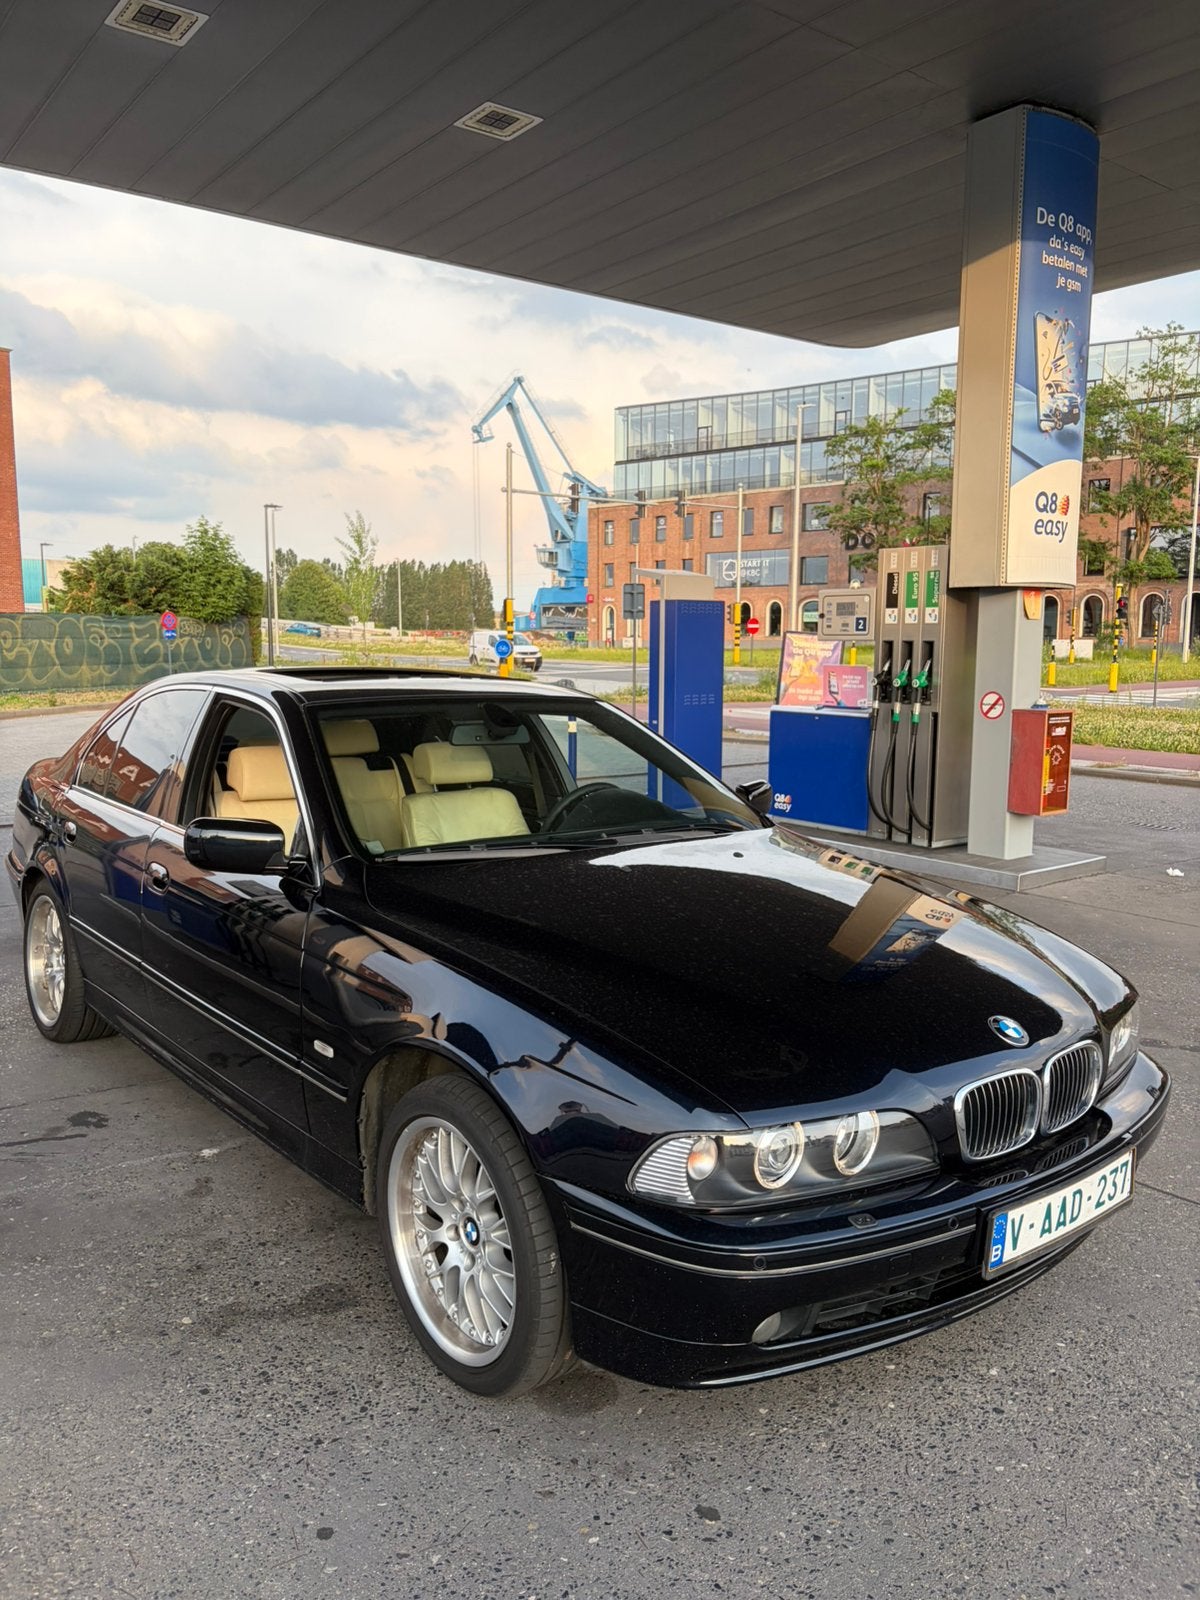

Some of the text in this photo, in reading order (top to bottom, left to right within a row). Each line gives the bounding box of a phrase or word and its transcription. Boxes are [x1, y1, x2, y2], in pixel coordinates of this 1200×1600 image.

[1036, 206, 1056, 227] De
[1058, 212, 1074, 233] Q8
[1049, 234, 1085, 261] da's easy
[1042, 250, 1088, 278] betalen met
[1055, 272, 1082, 292] je gsm
[1035, 491, 1058, 514] Q8
[1034, 518, 1069, 543] easy
[740, 559, 770, 568] START IT
[891, 572, 899, 595] Diesel
[912, 571, 919, 582] 95
[911, 583, 919, 600] Euro
[932, 583, 940, 604] Super
[857, 619, 865, 630] 2
[774, 793, 785, 802] Q8
[774, 802, 792, 812] easy
[1011, 1160, 1129, 1250] V-AAD-237
[991, 1244, 1002, 1262] B
